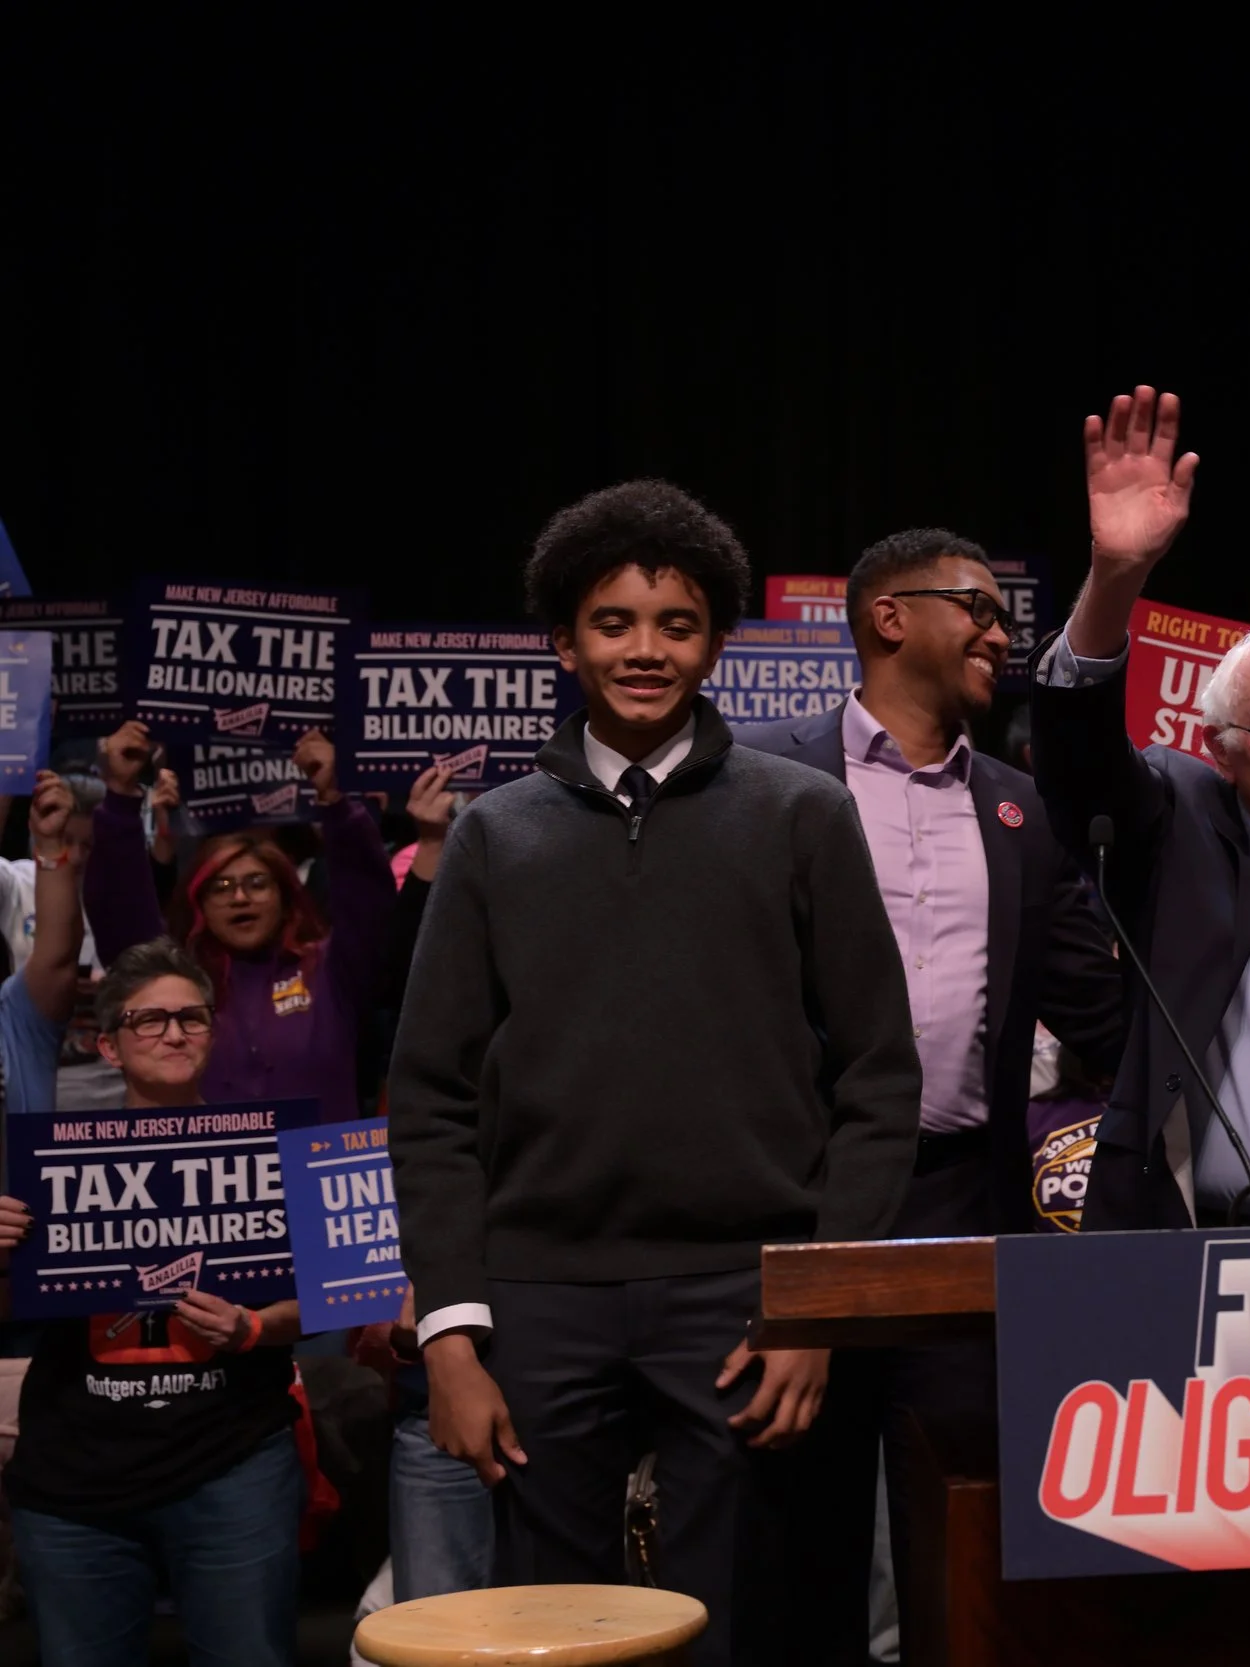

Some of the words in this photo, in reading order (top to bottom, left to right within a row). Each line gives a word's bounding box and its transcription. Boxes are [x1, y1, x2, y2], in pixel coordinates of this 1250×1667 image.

[165, 584, 197, 601] MAKE
[197, 586, 222, 603] NEW
[223, 588, 267, 608] JERSEY
[268, 592, 339, 613] AFFORDABLE
[370, 632, 404, 649] MAKE
[405, 632, 432, 648] NEW
[433, 632, 477, 649] JERSEY
[478, 633, 550, 650] AFFORDABLE
[1146, 610, 1211, 642] RIGHT
[151, 617, 240, 664] TAX
[252, 625, 335, 671] THE
[147, 664, 335, 703] BILLIONAIRES
[359, 667, 453, 708] TAX
[464, 667, 558, 709] THE
[701, 659, 861, 690] NIVERSAL
[699, 691, 850, 718] ALTHCAR
[363, 714, 556, 741] BILLIONAIRES
[192, 758, 308, 791] BILLIONA
[53, 1122, 93, 1142] MAKE
[96, 1119, 128, 1140] NEW
[131, 1117, 185, 1138] JERSEY
[187, 1111, 275, 1135] AFFORDABLE
[341, 1131, 368, 1151] TAX
[40, 1160, 158, 1215] TAX
[172, 1152, 285, 1207] THE
[47, 1208, 287, 1254] BILLIONAIRES
[148, 1257, 196, 1288] ANALILIA
[85, 1373, 146, 1402] Rutgers
